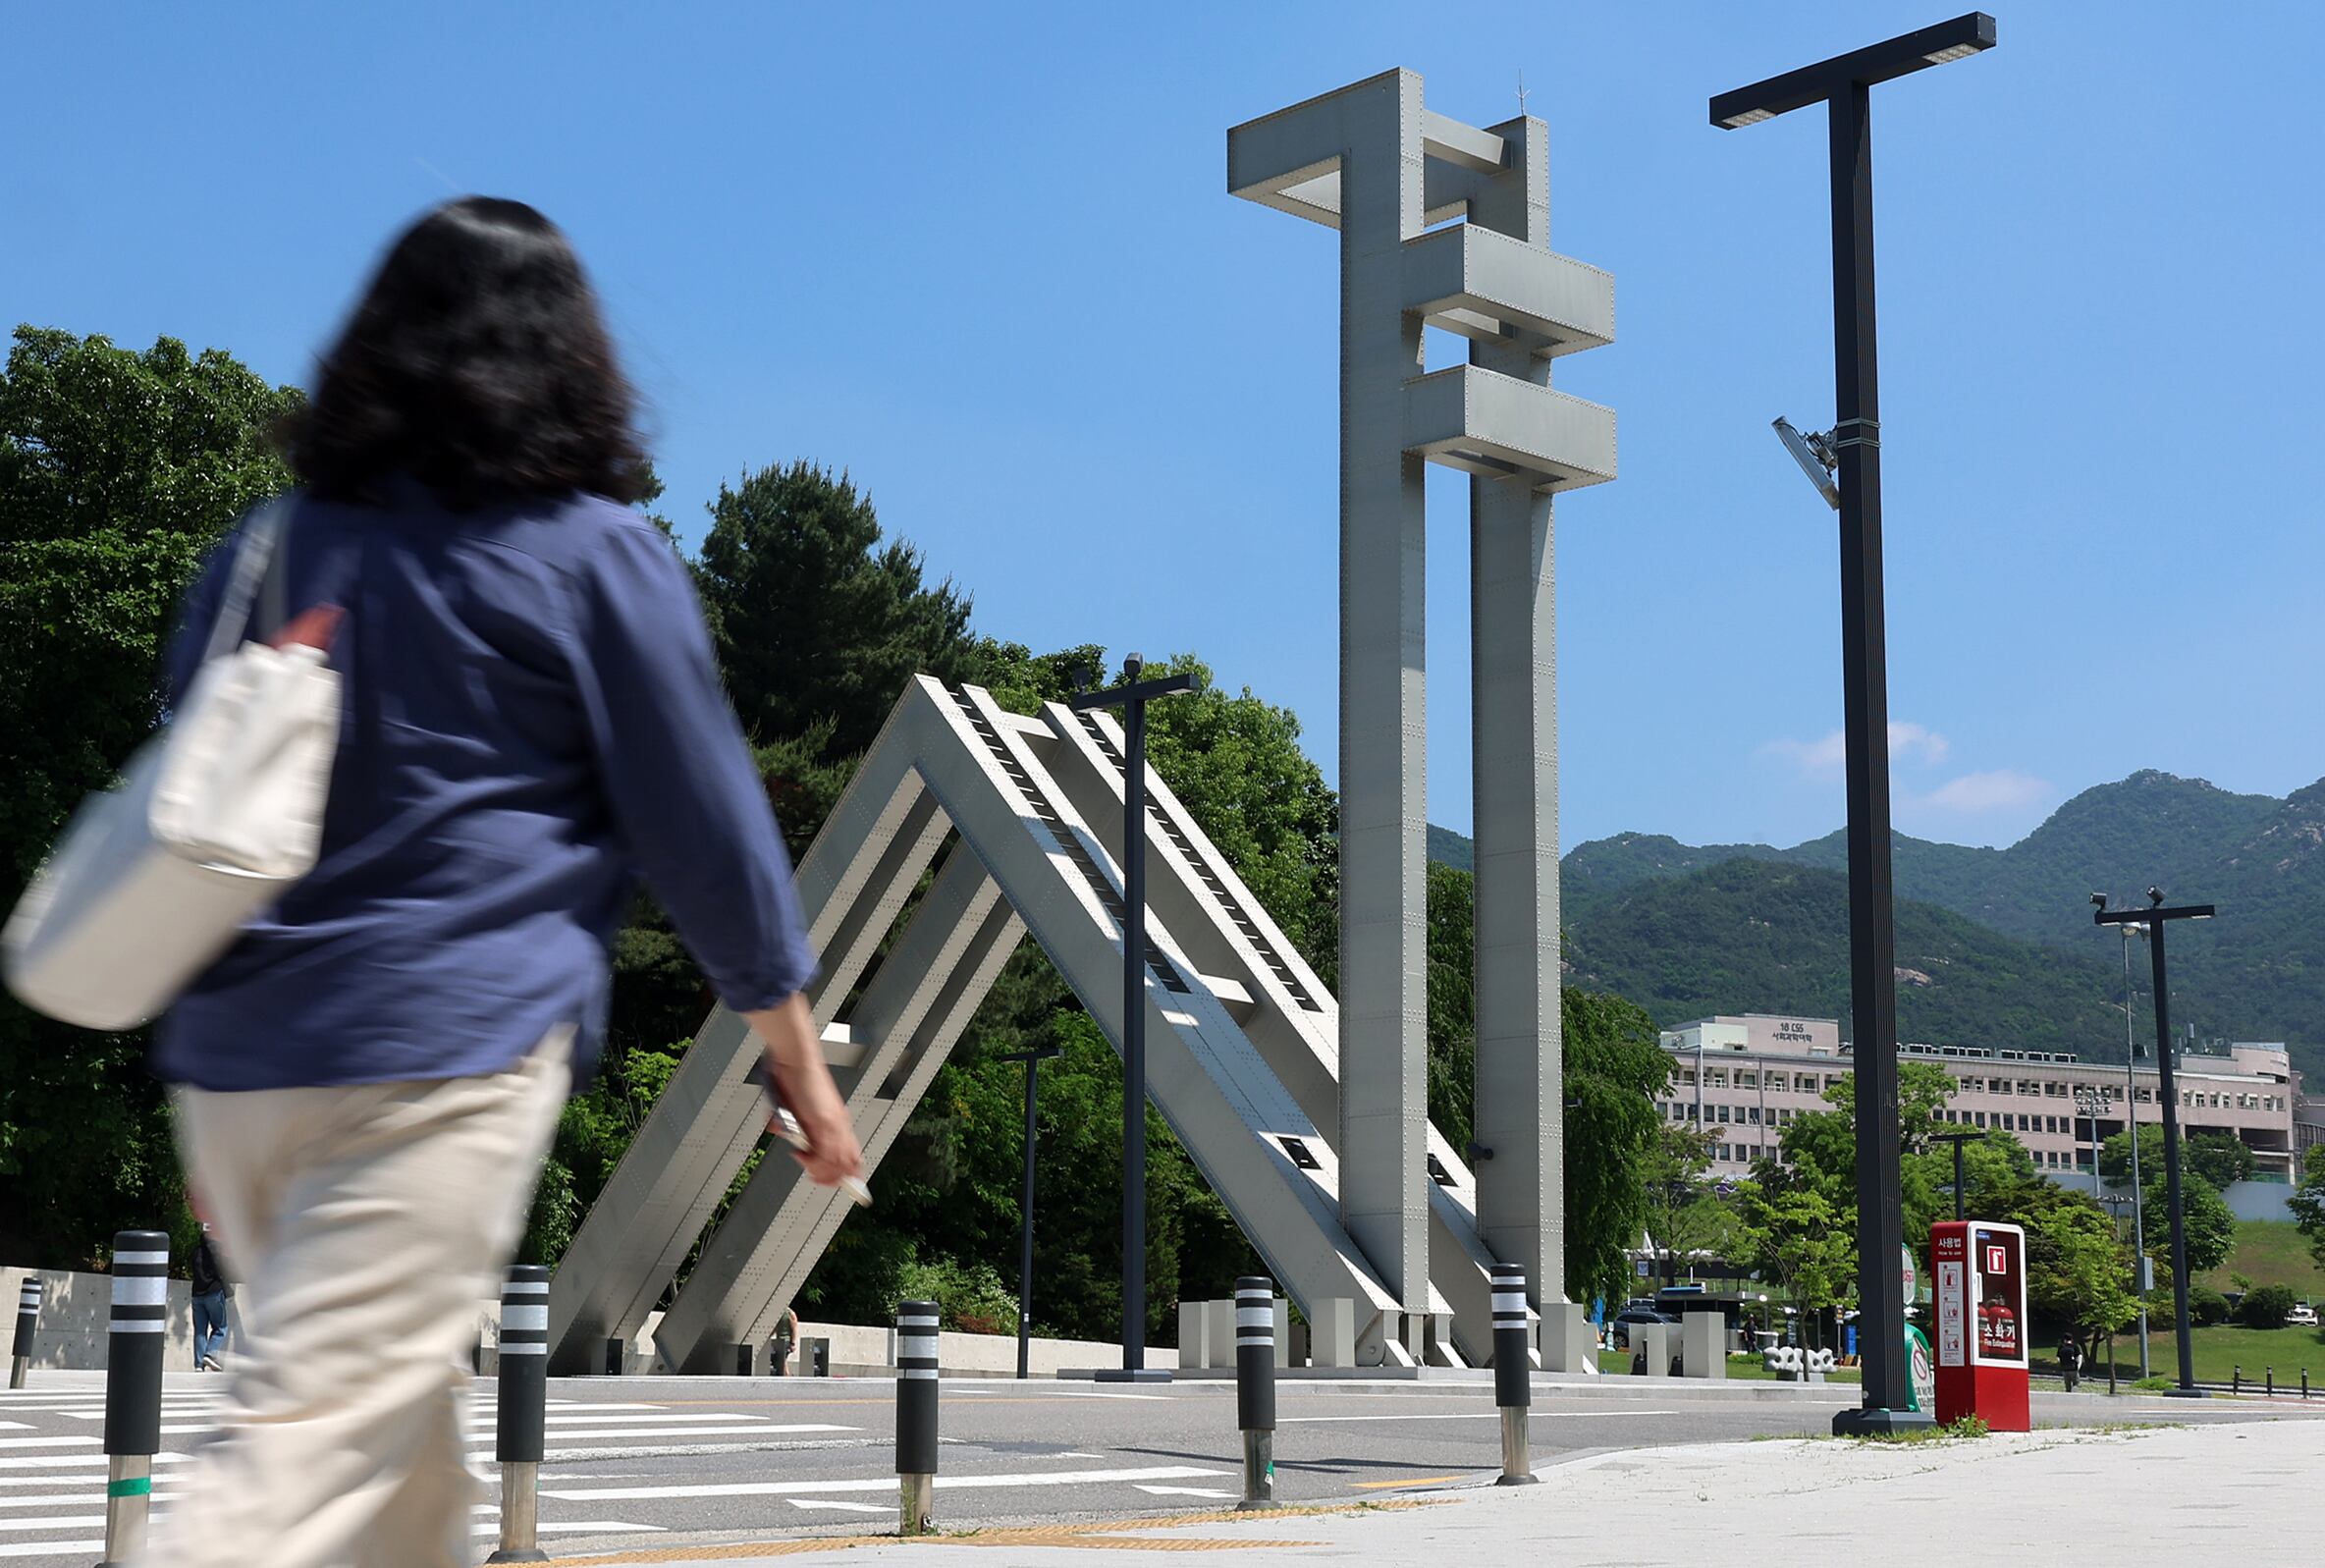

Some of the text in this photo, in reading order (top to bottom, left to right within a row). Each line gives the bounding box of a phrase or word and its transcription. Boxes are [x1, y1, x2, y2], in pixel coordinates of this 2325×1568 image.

[1780, 1022, 1804, 1033] 18 CSS
[1773, 1032, 1812, 1042] 사회과학대학
[1938, 1237, 1961, 1248] 사용법
[1984, 1323, 2015, 1340] 소화기
